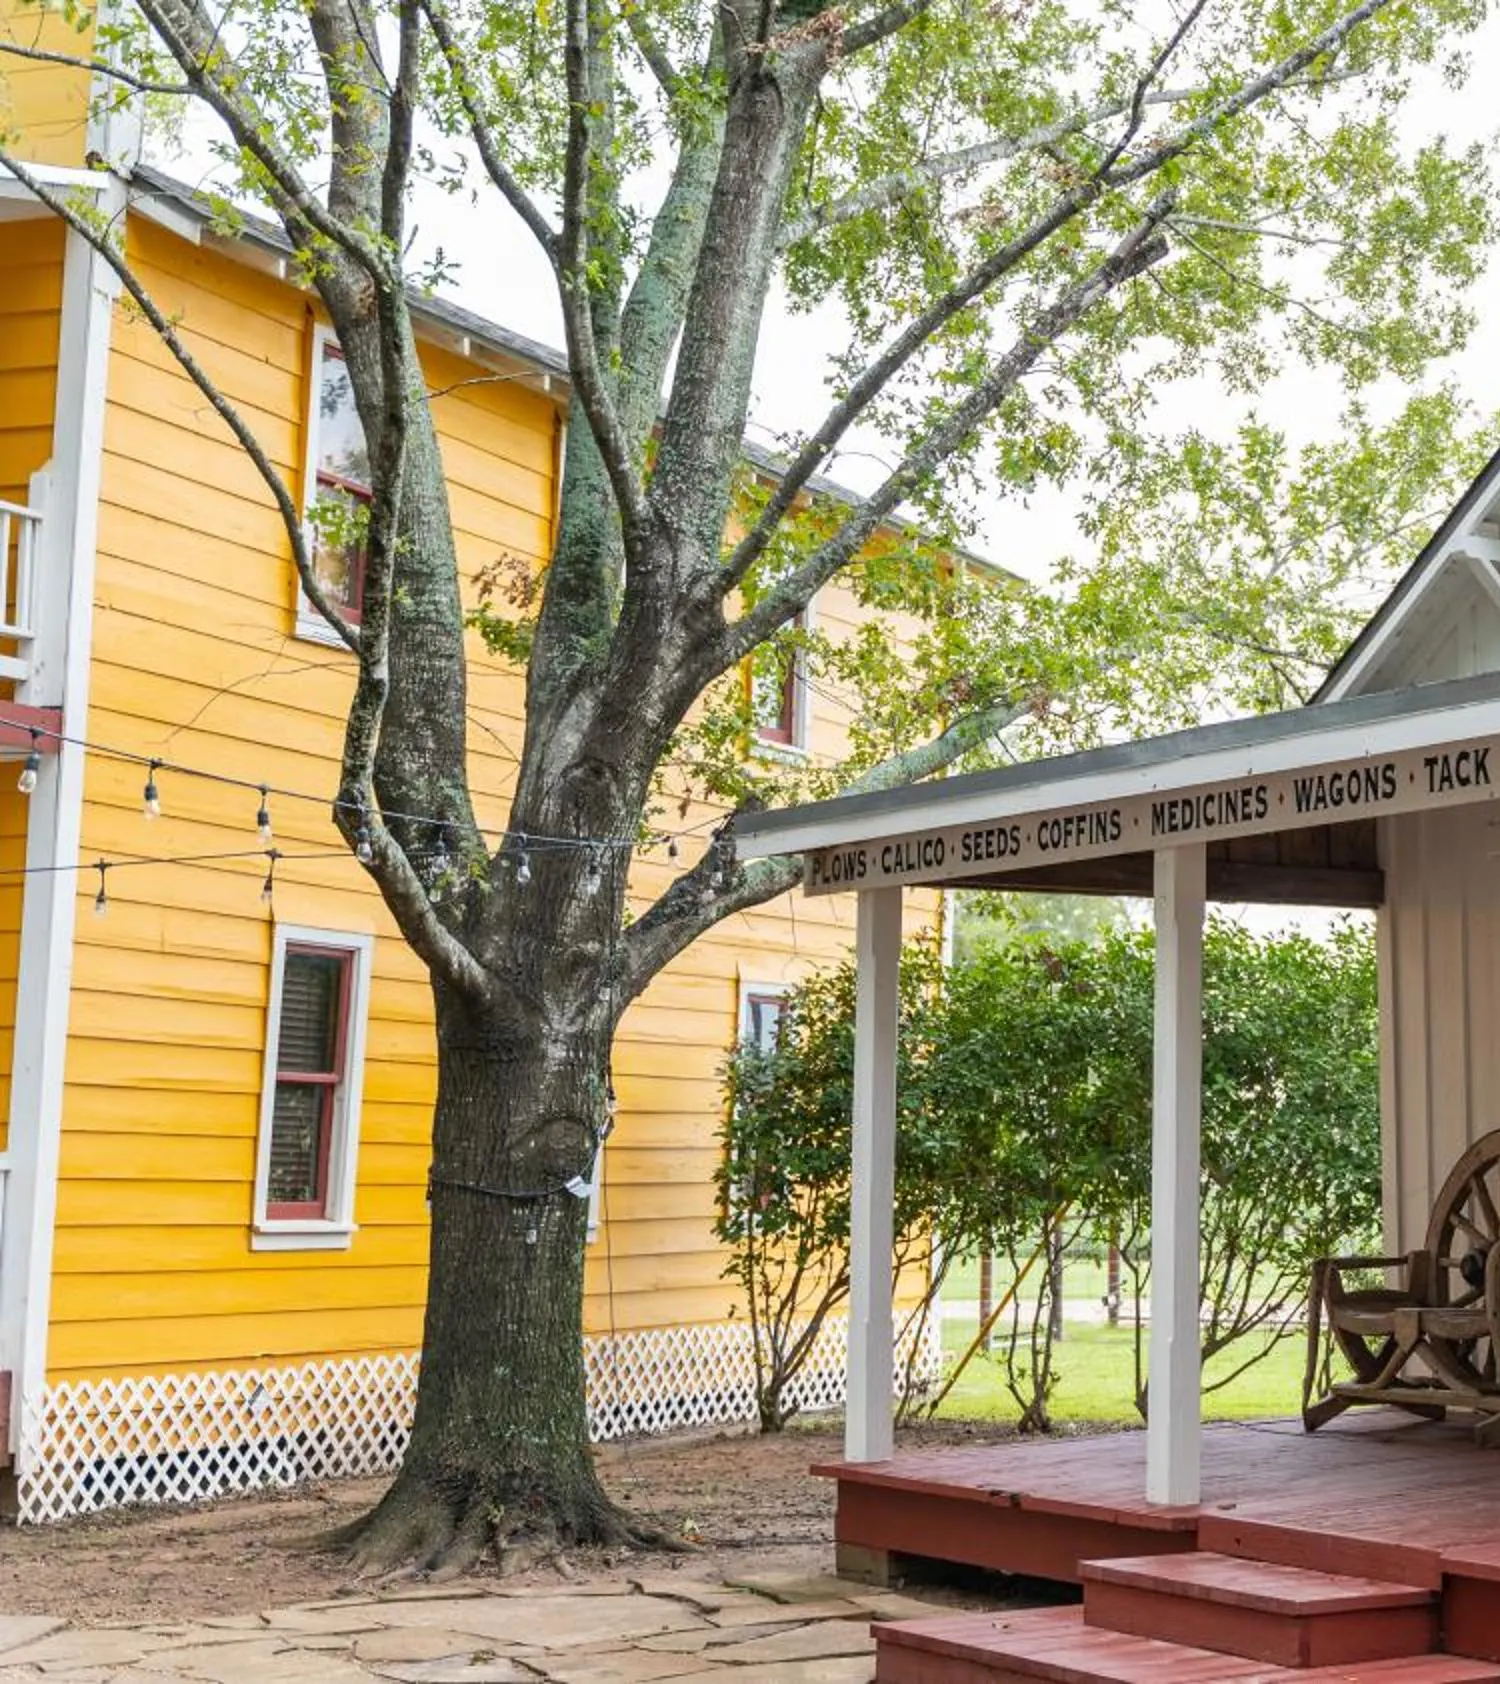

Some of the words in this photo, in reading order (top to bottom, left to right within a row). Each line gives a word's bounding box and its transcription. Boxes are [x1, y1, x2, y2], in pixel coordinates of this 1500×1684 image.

[811, 850, 867, 886] PLOWS
[881, 837, 945, 874] CALICO
[961, 825, 1021, 862] SEEDS
[1037, 810, 1122, 850] COFFINS
[1151, 785, 1268, 836] MEDICINES
[1293, 763, 1396, 813] WAGONS
[1423, 747, 1491, 793] TACK
